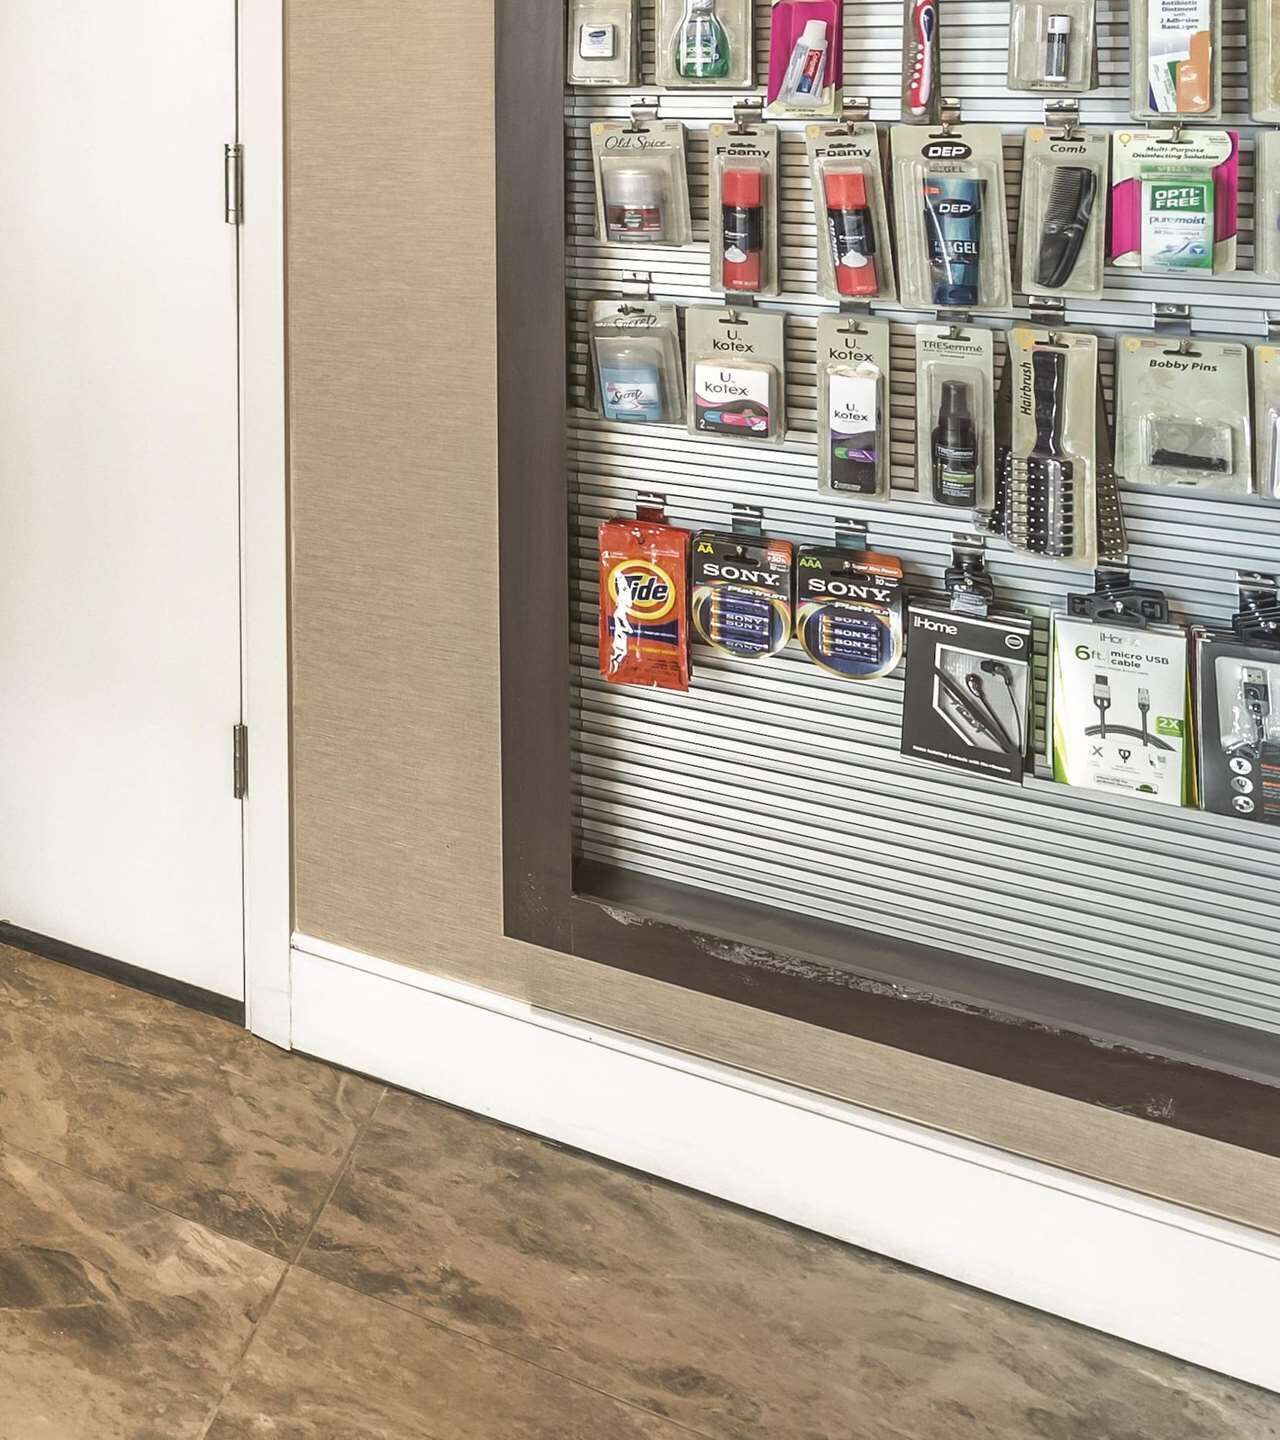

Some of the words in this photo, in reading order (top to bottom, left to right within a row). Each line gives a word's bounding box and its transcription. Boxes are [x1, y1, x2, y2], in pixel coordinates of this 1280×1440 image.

[604, 136, 630, 150] Old
[632, 136, 666, 151] Spice
[1049, 143, 1087, 155] Comb
[716, 147, 770, 159] Foamy
[815, 147, 872, 159] Foamy
[928, 146, 967, 157] DEP
[1186, 152, 1220, 160] Solution
[1154, 188, 1200, 201] OPTI-
[939, 203, 972, 213] DEP
[1155, 196, 1200, 208] FREE
[953, 241, 978, 255] GEL
[713, 340, 754, 353] kotex
[829, 349, 873, 362] kotex
[1149, 359, 1188, 372] Bobby
[1190, 361, 1218, 372] Pins
[704, 383, 748, 396] kotex
[1020, 361, 1032, 416] Hairbrush
[833, 409, 868, 421] kotex
[696, 544, 714, 554] AA
[799, 558, 823, 569] AAA
[913, 619, 958, 635] iHome
[1110, 649, 1142, 662] micro
[1145, 655, 1170, 665] USB
[1111, 658, 1141, 669] cable
[1158, 717, 1179, 730] 2X
